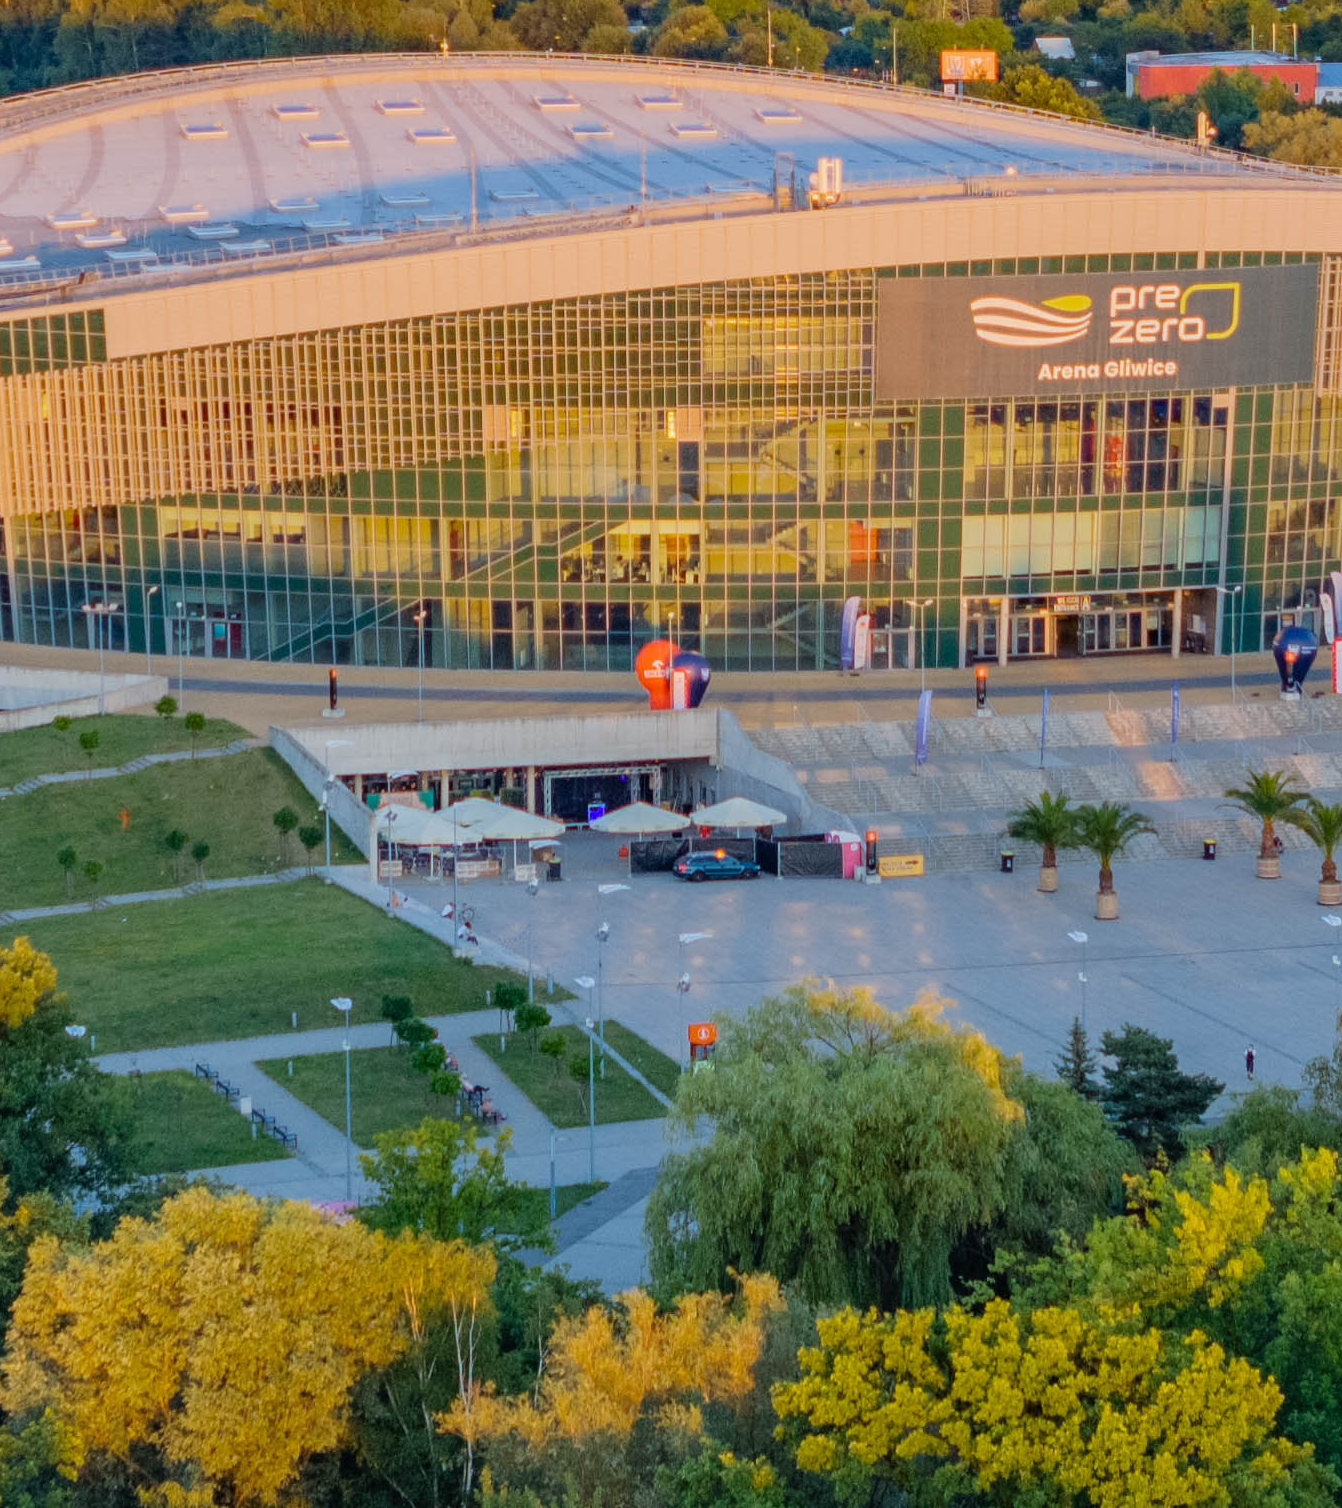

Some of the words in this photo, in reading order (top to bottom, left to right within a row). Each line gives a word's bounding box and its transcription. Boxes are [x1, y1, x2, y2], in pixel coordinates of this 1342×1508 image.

[1110, 284, 1180, 318] pre
[1110, 317, 1205, 343] zero
[1038, 361, 1100, 381] Arena
[1104, 357, 1177, 378] Gliwice
